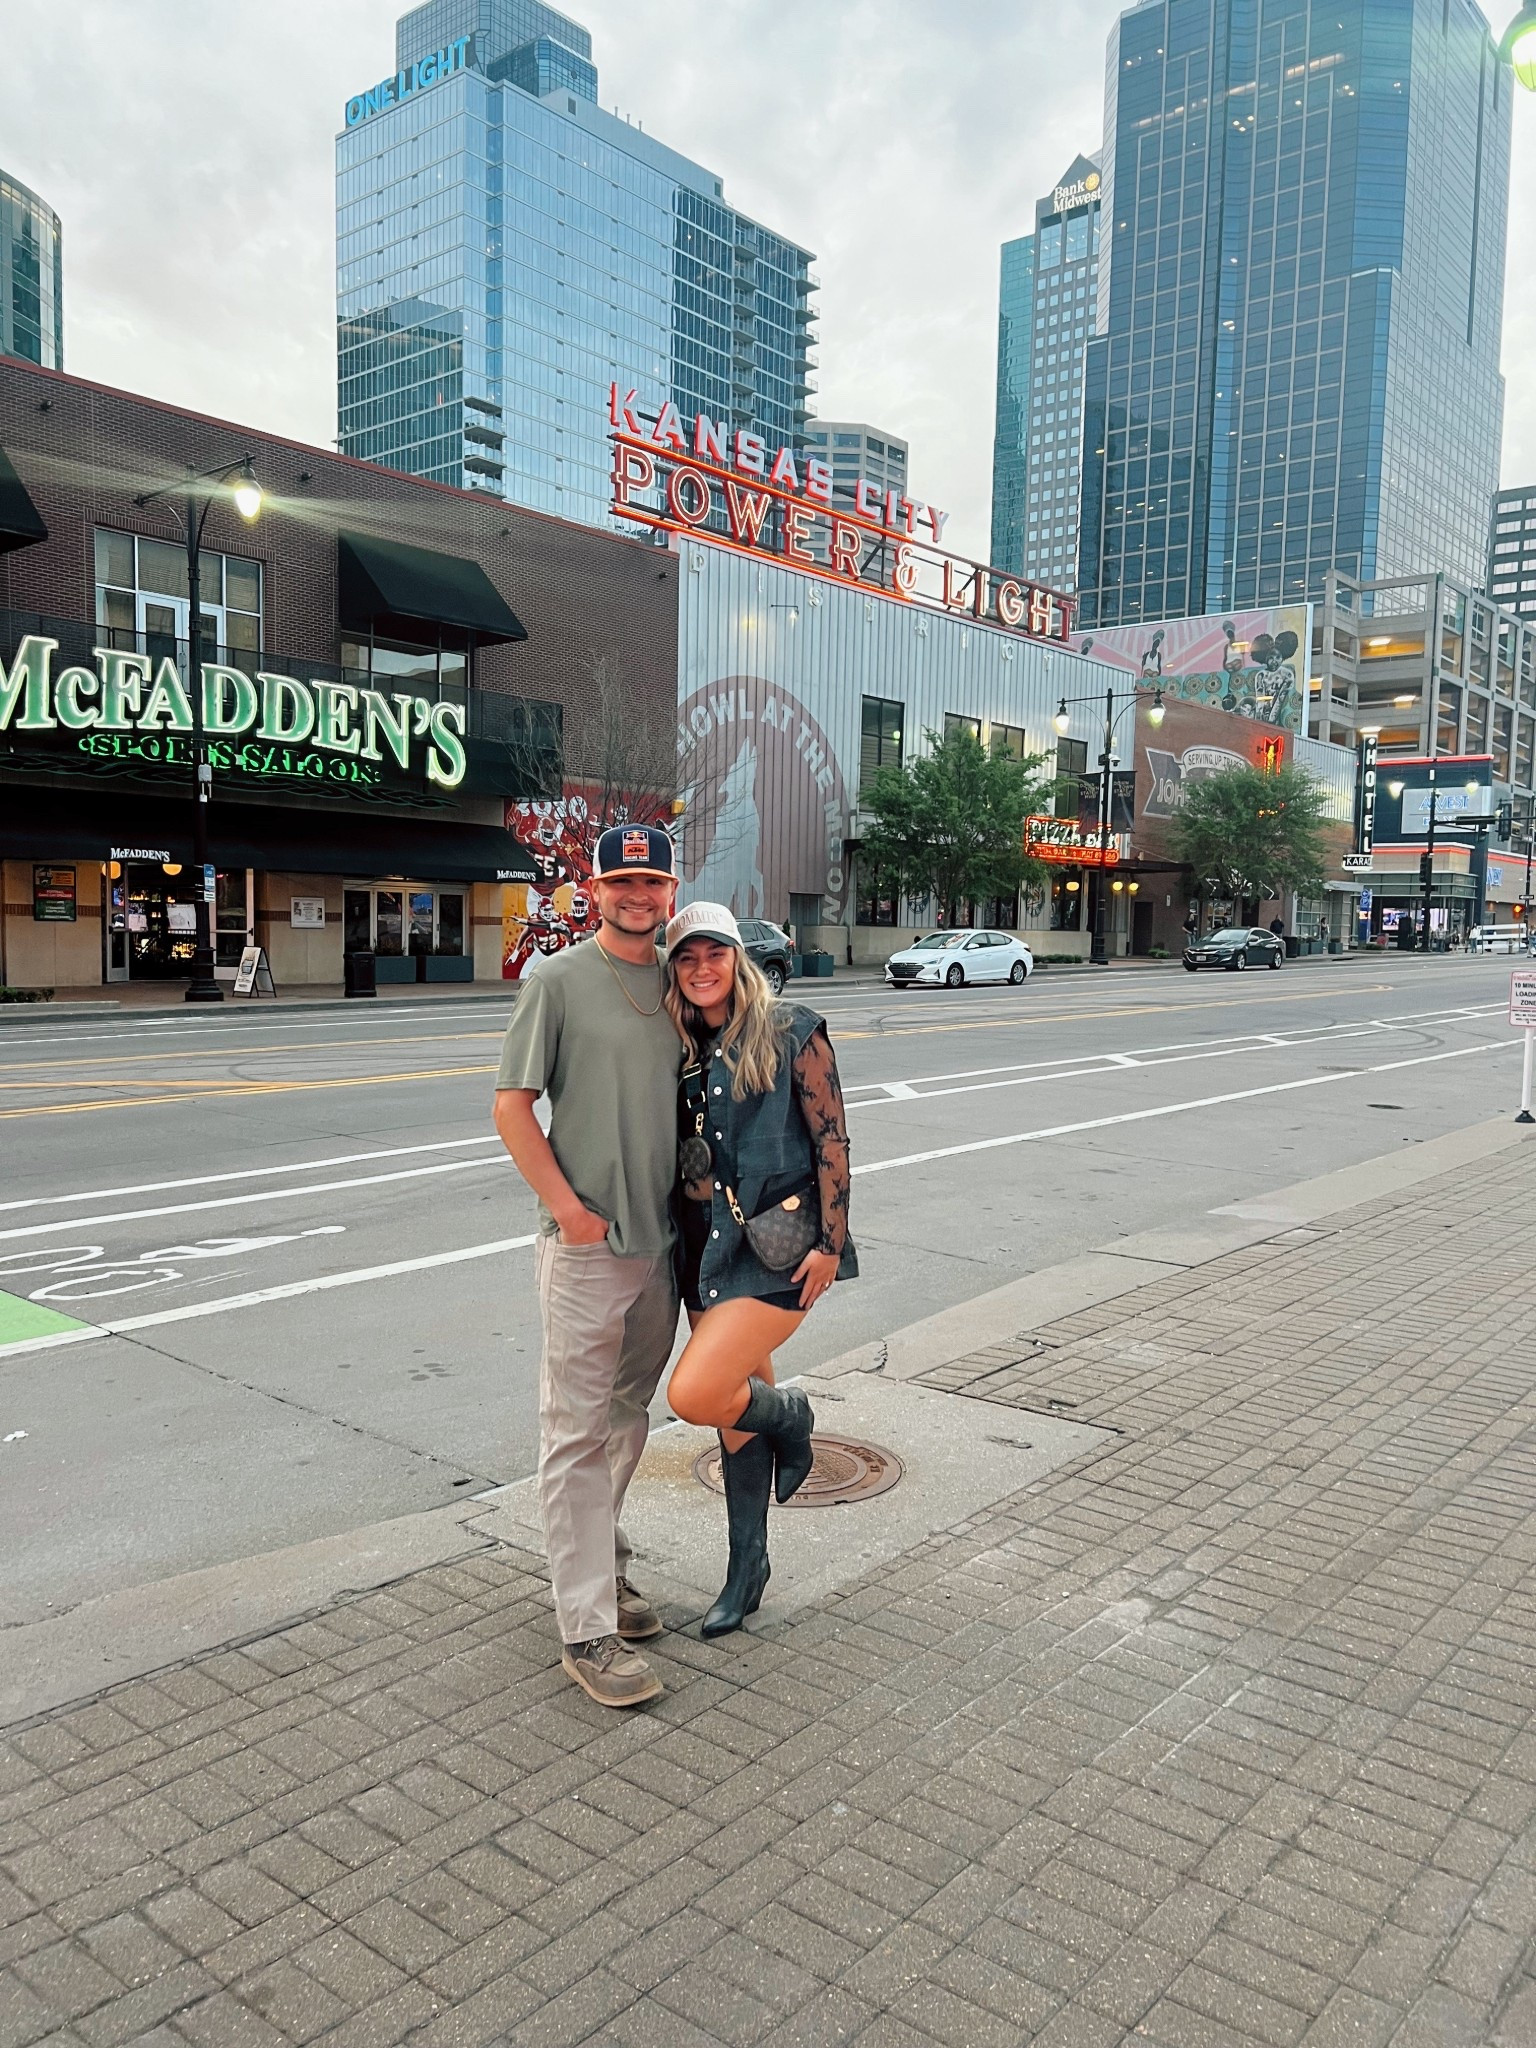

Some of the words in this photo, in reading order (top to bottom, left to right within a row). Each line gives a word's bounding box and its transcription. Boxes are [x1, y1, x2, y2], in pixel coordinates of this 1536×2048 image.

[347, 77, 396, 125] ONE
[399, 34, 471, 100] LIGHT
[1053, 186, 1101, 213] Midwest
[1054, 180, 1085, 201] Bank
[610, 381, 834, 501] KANSAS
[856, 478, 949, 543] CITY
[611, 443, 862, 580] POWER
[893, 543, 920, 595] &
[944, 559, 1078, 643] LIGHT
[677, 688, 755, 757] HOWL
[761, 695, 795, 734] AT
[795, 720, 835, 794] THE
[1363, 749, 1377, 853] HOTEL
[110, 847, 171, 863] McFADDEN'S
[1029, 819, 1081, 847] PIZZA
[496, 870, 537, 882] McFADDEN'S
